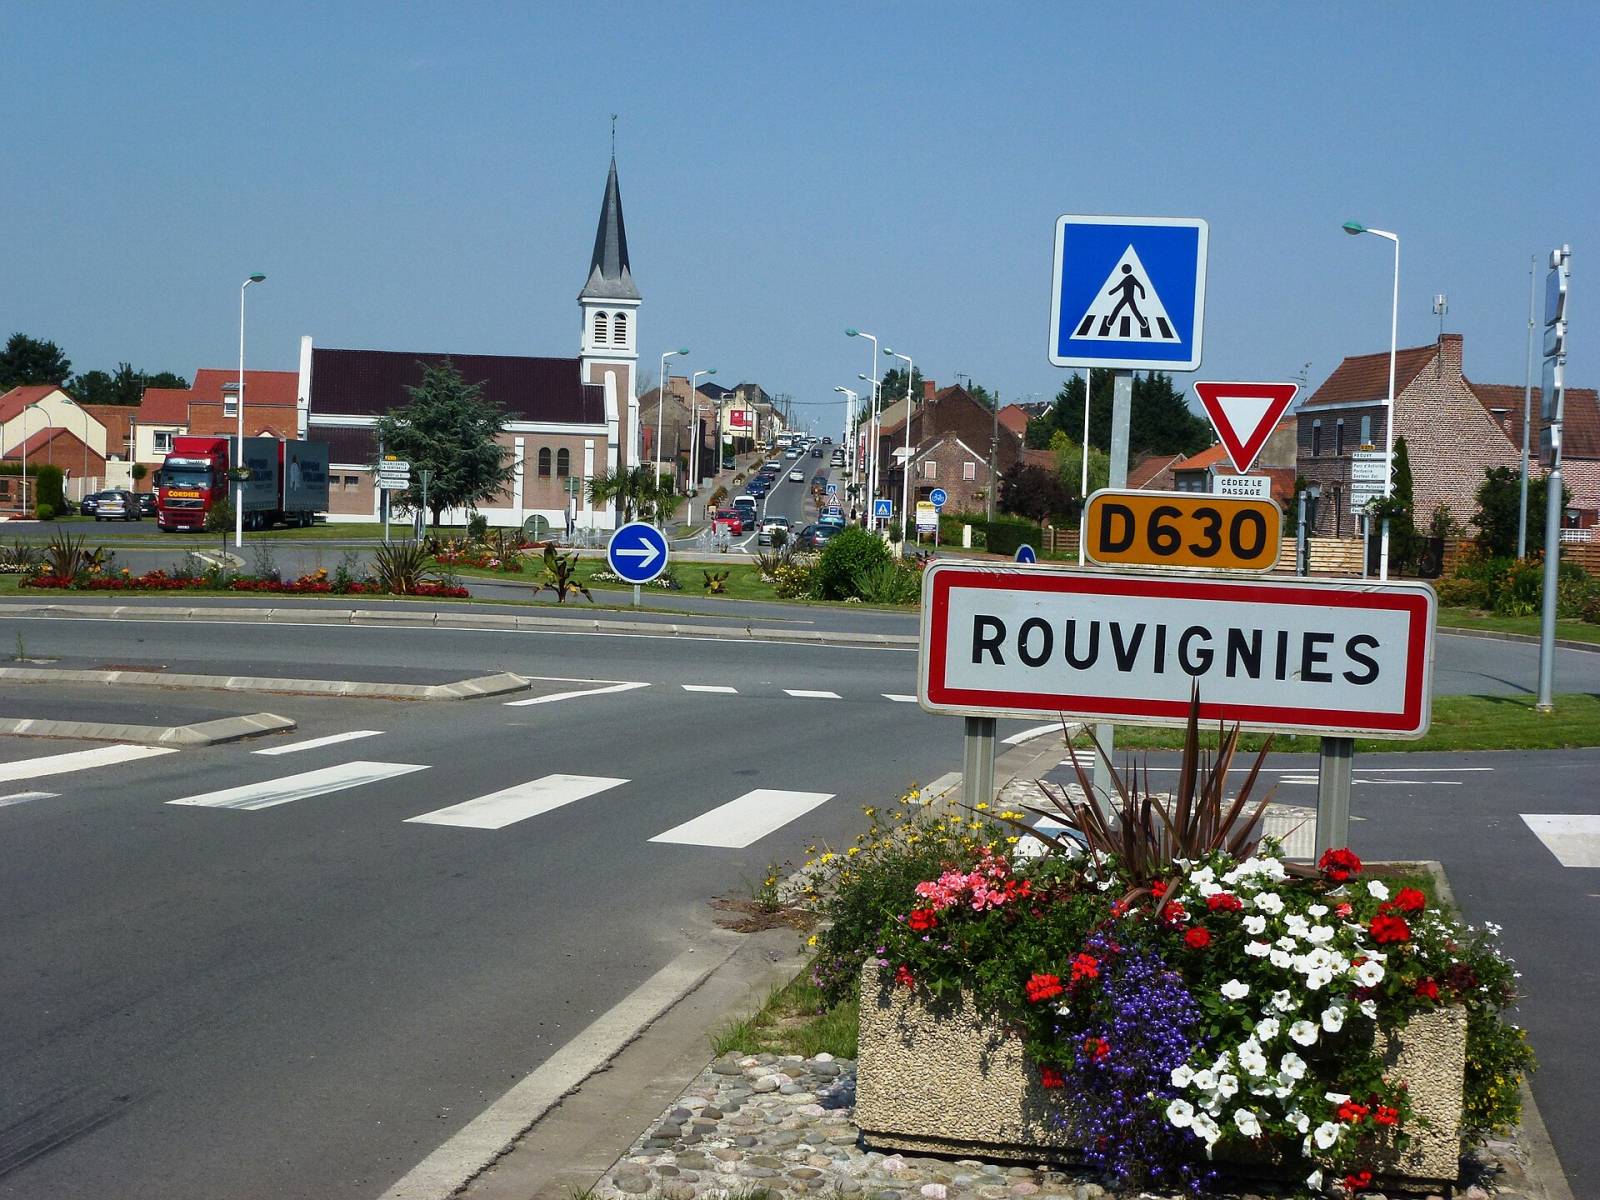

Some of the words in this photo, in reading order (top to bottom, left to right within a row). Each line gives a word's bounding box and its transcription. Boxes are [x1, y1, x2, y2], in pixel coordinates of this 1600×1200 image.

[1221, 478, 1249, 487] CÉDEZ
[168, 490, 200, 498] CORDIER
[1222, 488, 1261, 496] PASSAGE
[971, 614, 1381, 686] ROUVIGNIES
